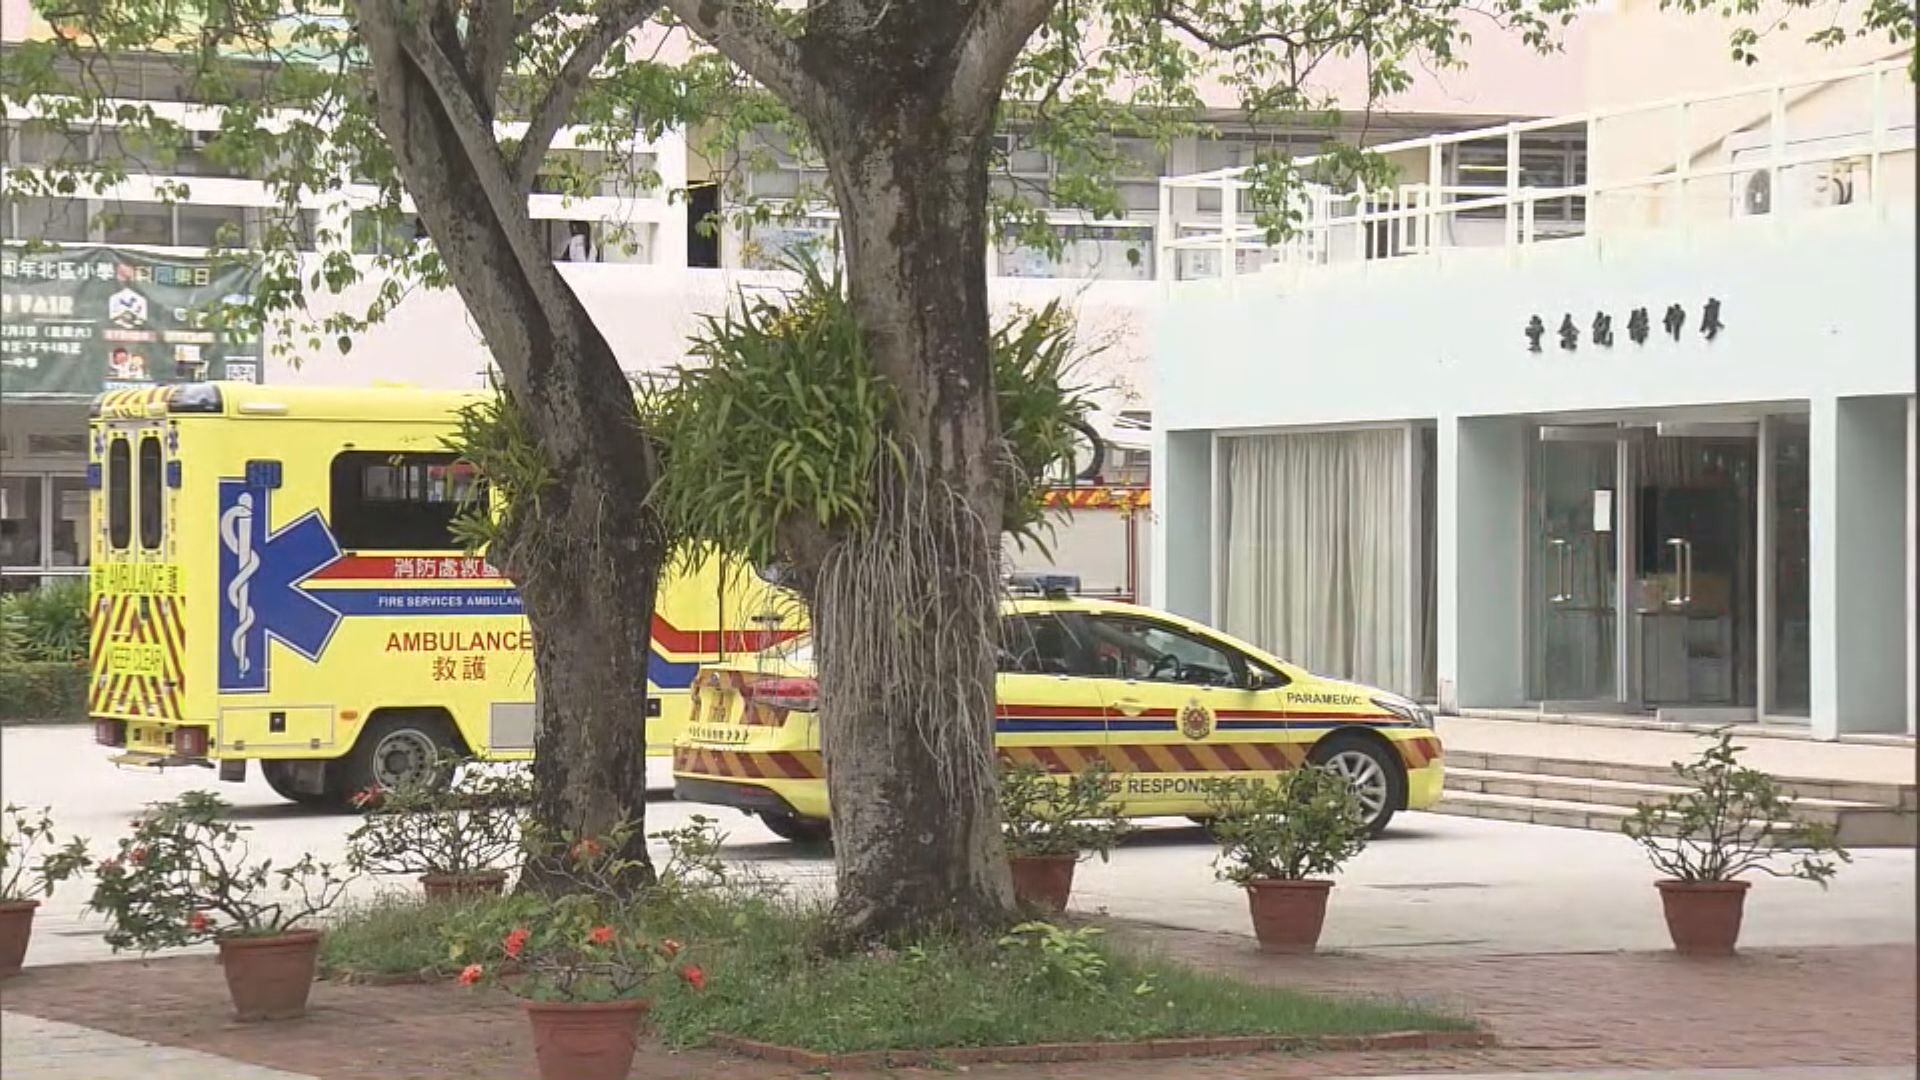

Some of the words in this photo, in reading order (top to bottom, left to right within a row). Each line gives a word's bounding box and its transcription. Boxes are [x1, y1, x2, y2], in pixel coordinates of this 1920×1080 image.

[108, 564, 164, 594] AMBULANCE
[378, 596, 404, 608] FIRE
[407, 596, 463, 608] SERVICES
[385, 631, 533, 652] AMBULANCE
[433, 656, 487, 682] 救護
[1286, 691, 1363, 706] PARAMEDIC
